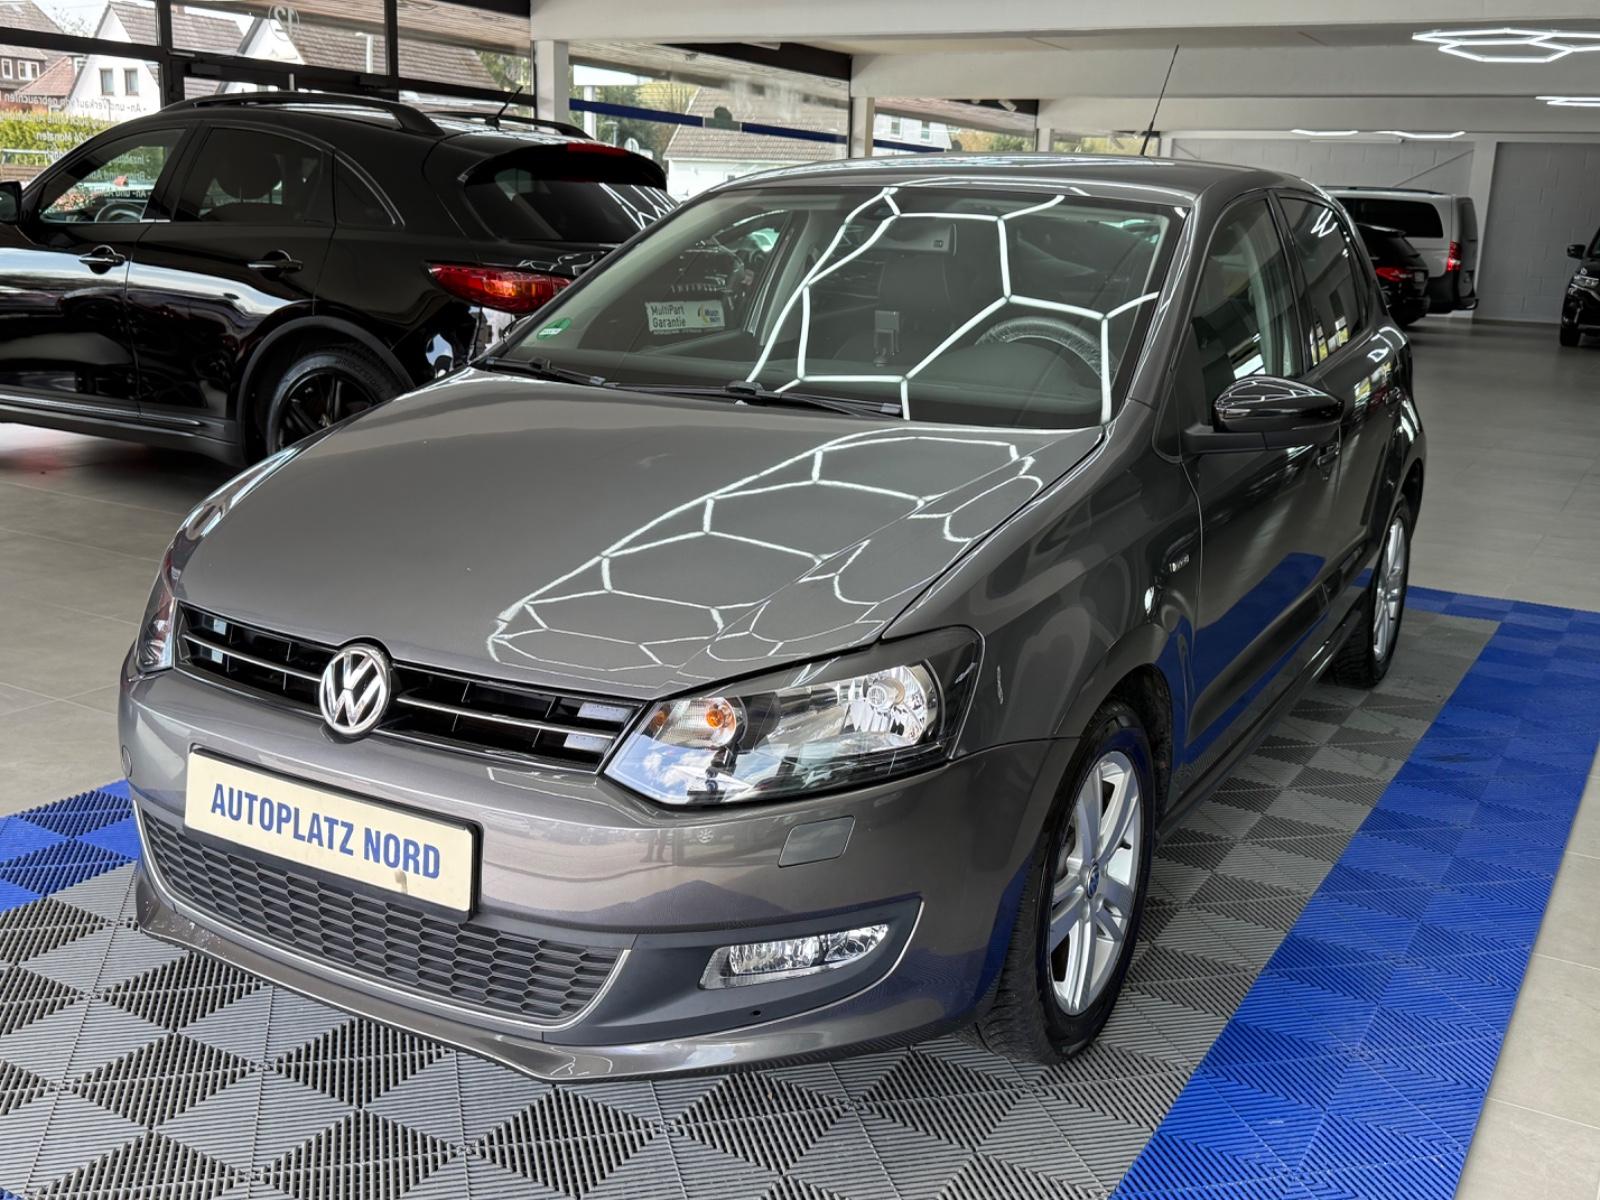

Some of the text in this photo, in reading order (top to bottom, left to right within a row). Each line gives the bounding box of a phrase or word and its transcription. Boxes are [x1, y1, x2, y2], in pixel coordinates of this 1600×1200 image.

[650, 303, 686, 316] MultiPart
[652, 315, 687, 328] Garantie
[211, 783, 441, 880] AUTOPLATZ NORD
